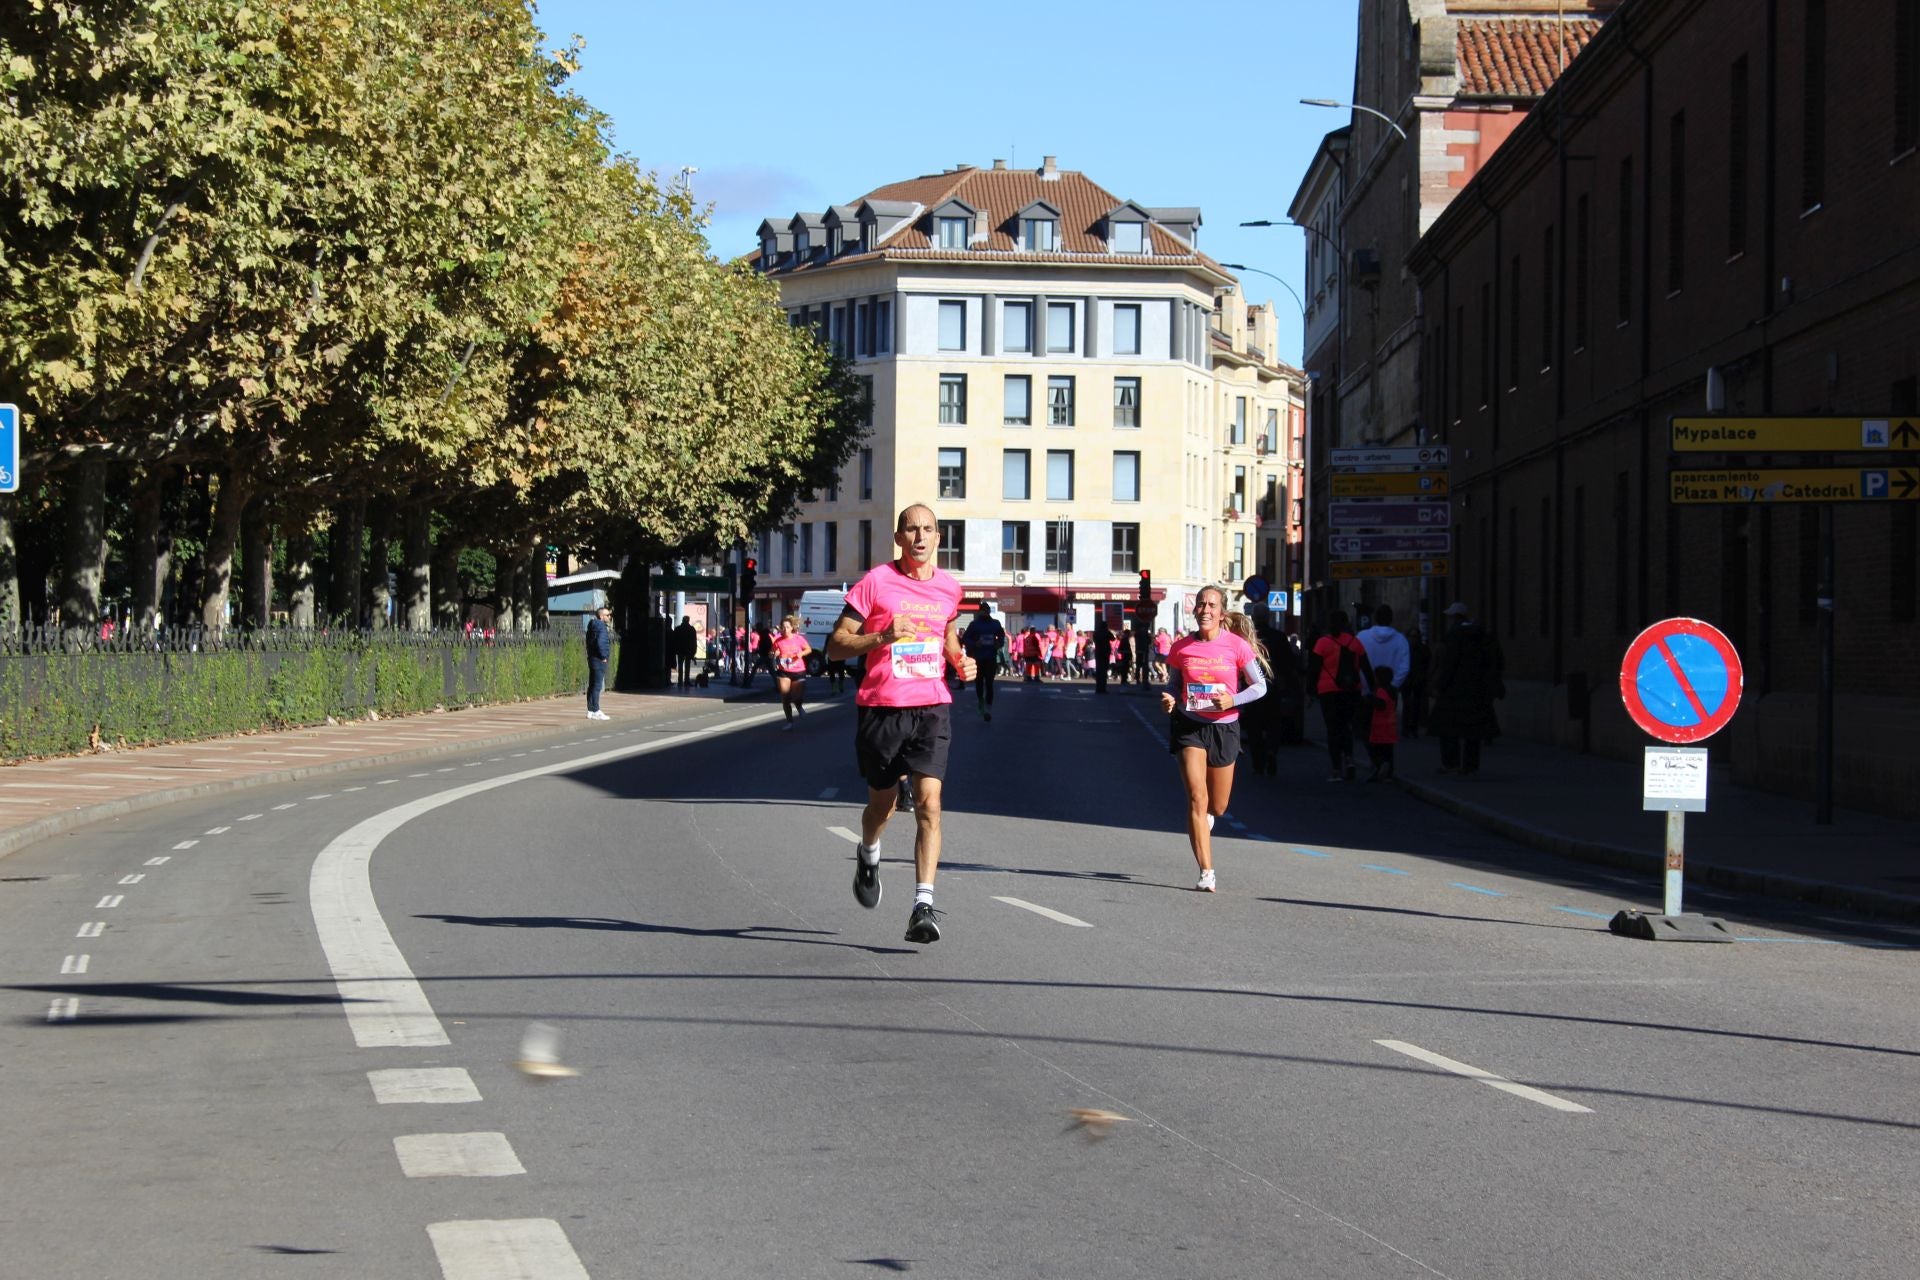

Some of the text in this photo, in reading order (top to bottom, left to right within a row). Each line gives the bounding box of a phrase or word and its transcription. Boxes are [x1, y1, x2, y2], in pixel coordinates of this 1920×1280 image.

[1674, 426, 1757, 443] Mypalace
[1363, 453, 1392, 461] urbano
[1674, 471, 1760, 482] aparcamiento
[1421, 478, 1430, 488] P
[1866, 473, 1885, 496] P
[1674, 486, 1718, 500] Plaza
[1782, 484, 1856, 498] Catedral
[965, 591, 985, 599] KING
[1075, 592, 1131, 601] BURGER KING
[910, 655, 933, 664] 5655
